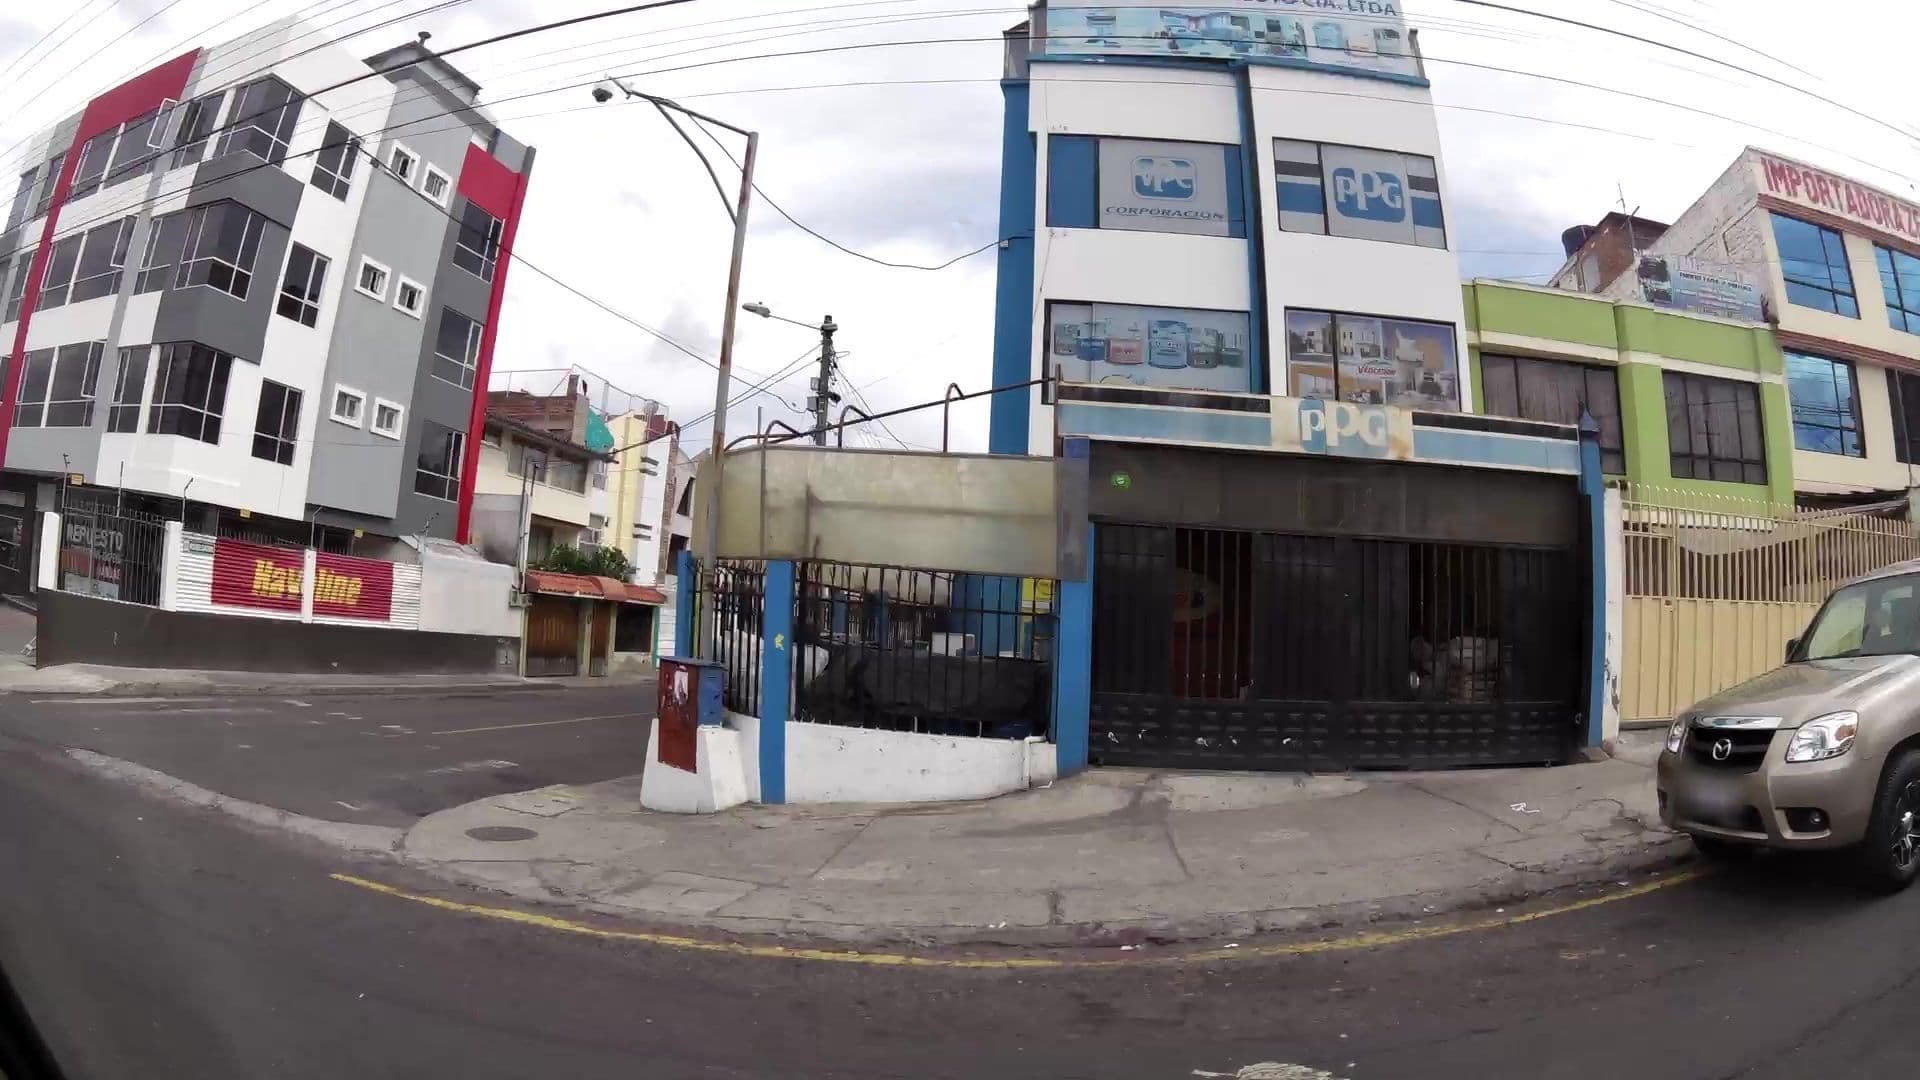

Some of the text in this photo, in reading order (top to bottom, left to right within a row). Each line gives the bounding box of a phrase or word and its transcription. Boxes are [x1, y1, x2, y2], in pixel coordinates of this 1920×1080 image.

[1346, 0, 1398, 16] LTDA
[1336, 171, 1403, 211] PPG
[1300, 404, 1387, 448] PPG
